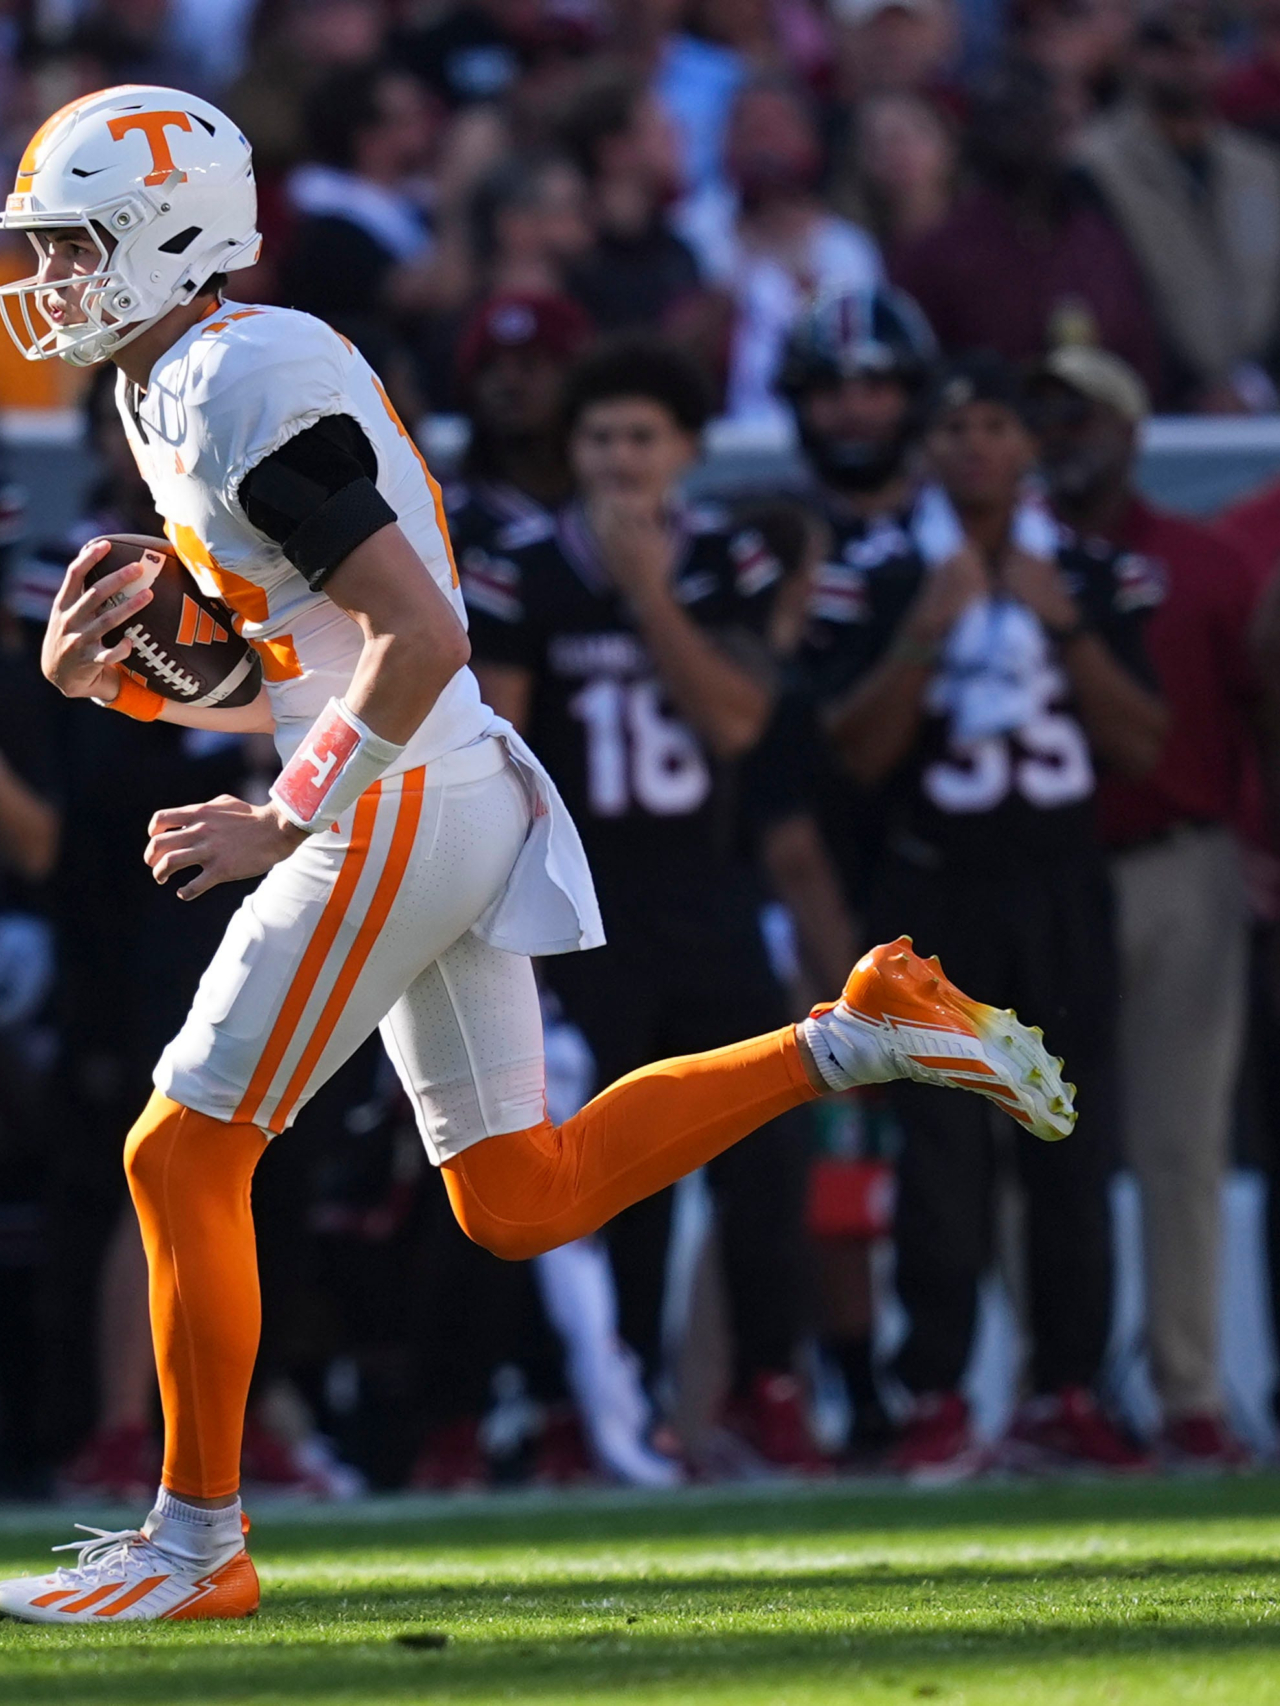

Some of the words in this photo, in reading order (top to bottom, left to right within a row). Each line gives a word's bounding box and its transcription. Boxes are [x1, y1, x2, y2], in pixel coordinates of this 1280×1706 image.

[106, 111, 193, 187] T
[300, 741, 338, 789] T
[570, 680, 711, 817] 16
